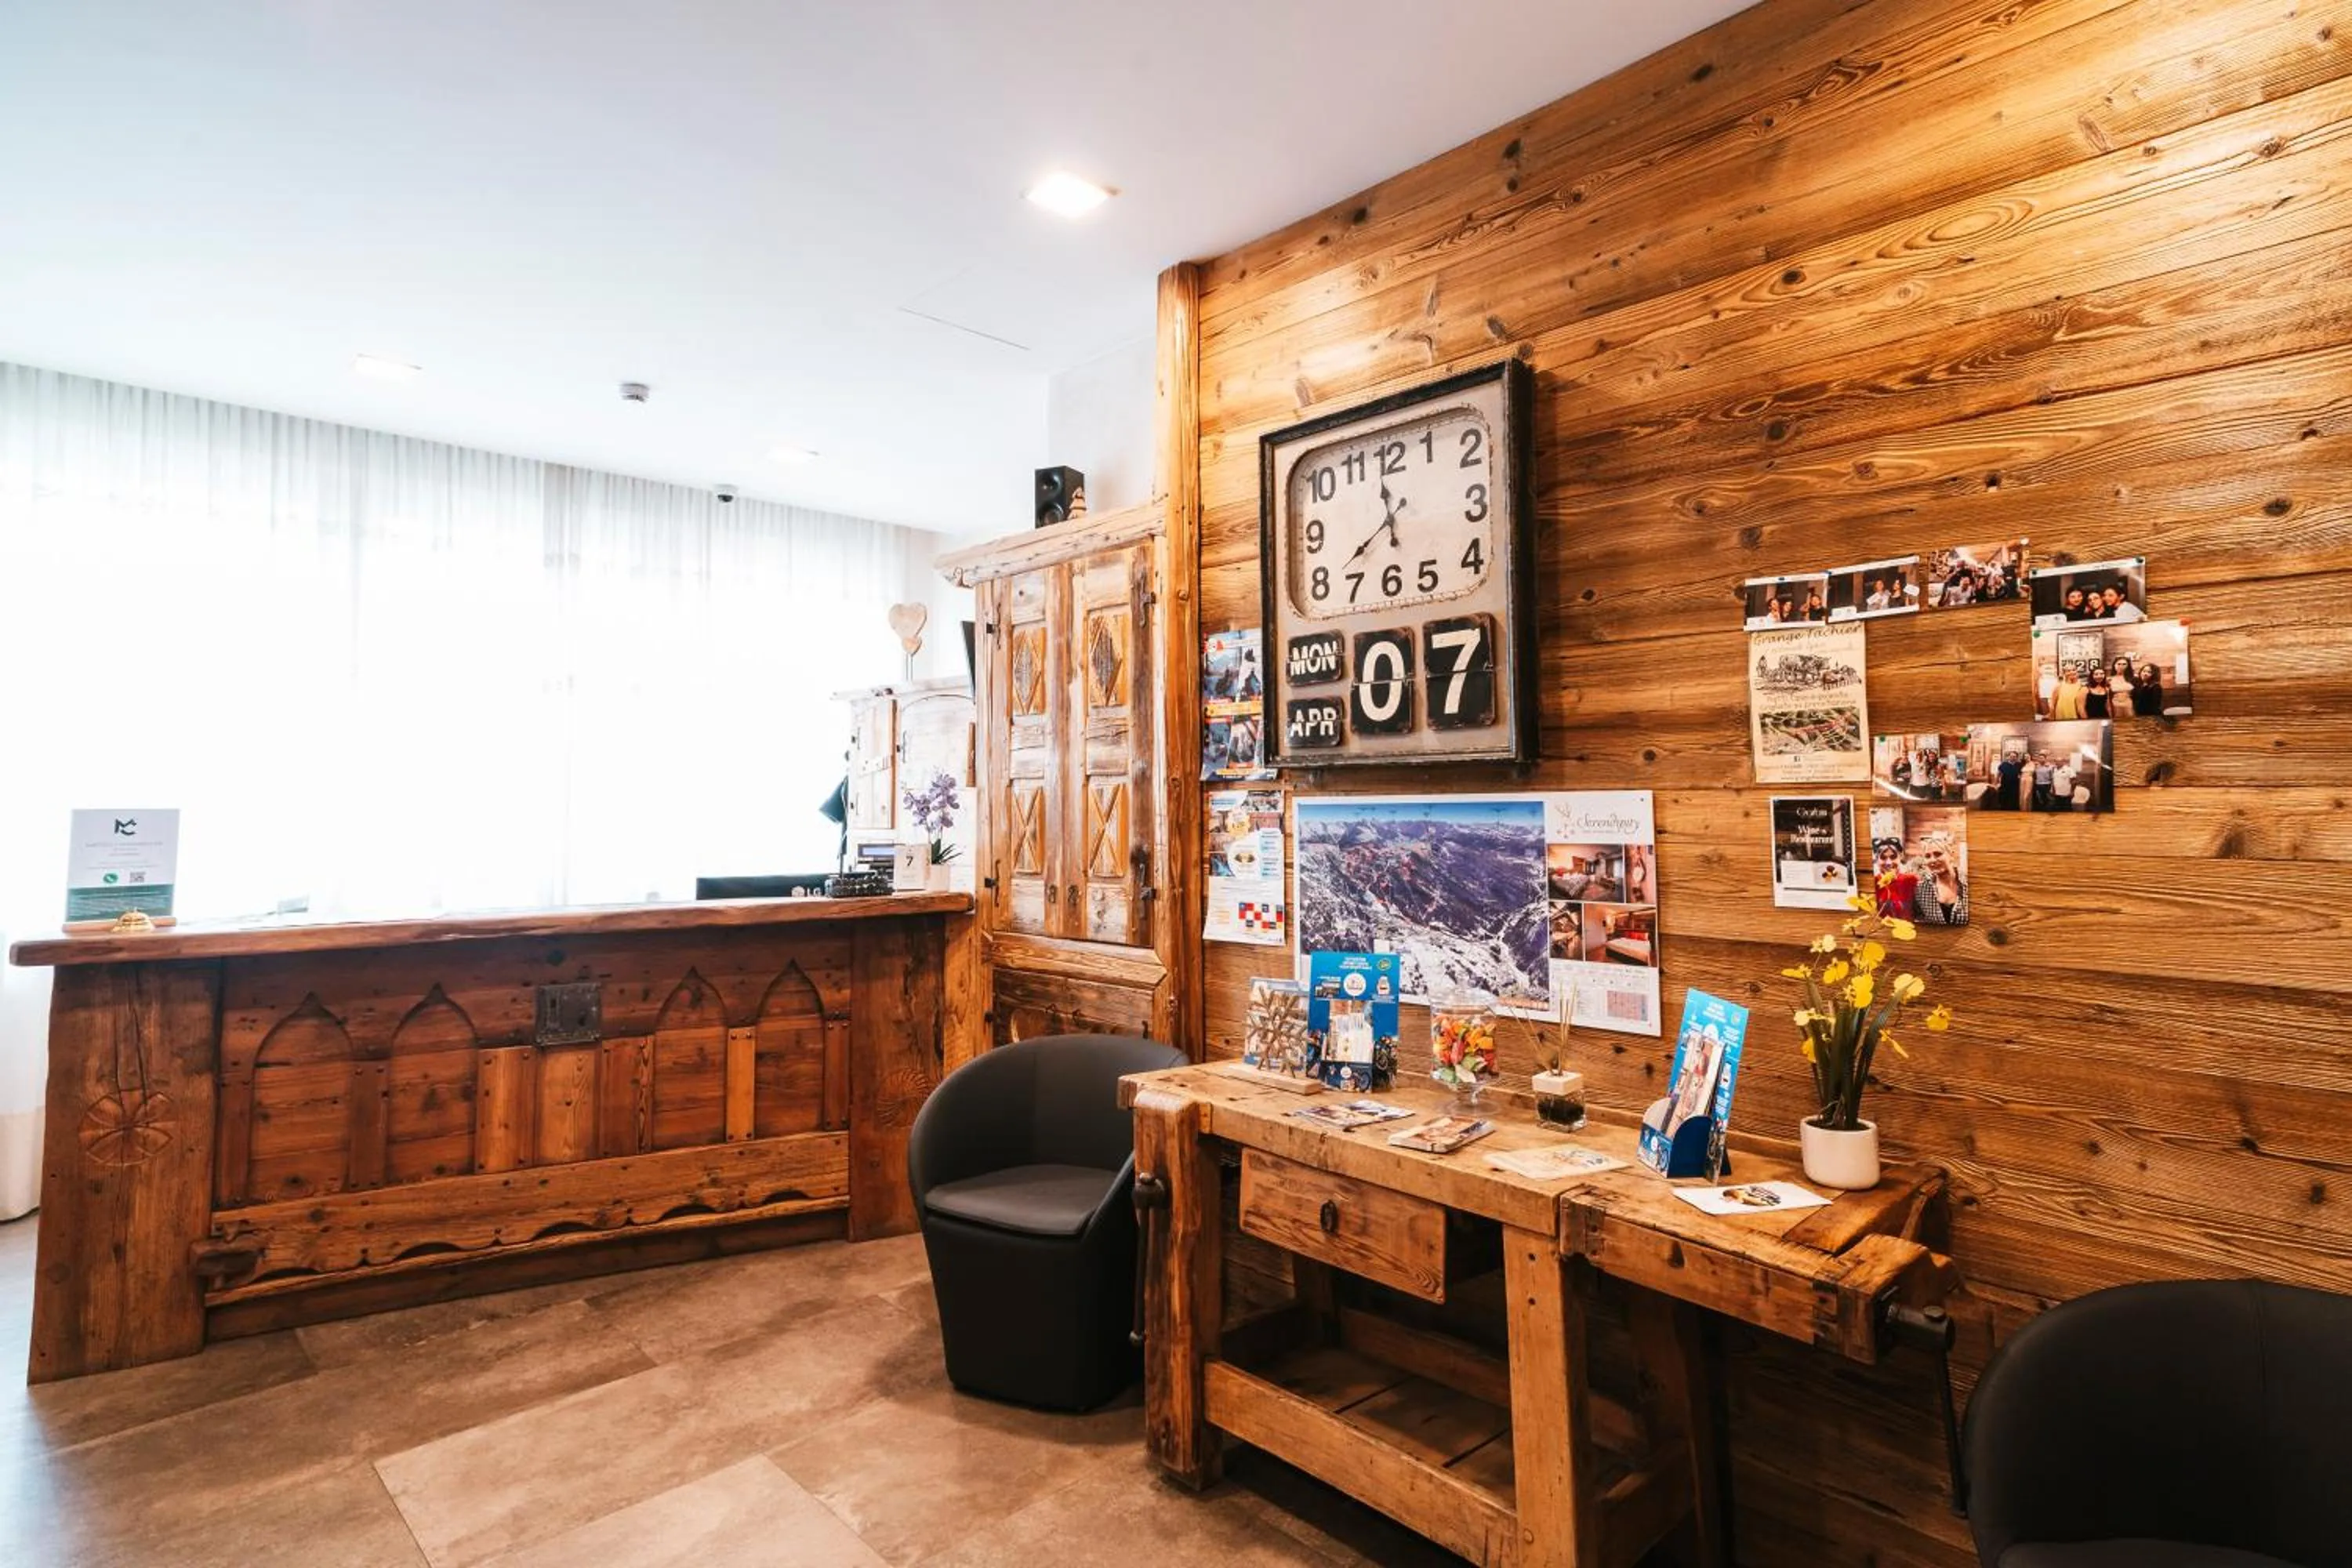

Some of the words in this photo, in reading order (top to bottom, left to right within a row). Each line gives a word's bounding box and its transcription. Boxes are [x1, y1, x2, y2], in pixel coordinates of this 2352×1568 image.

[1374, 441, 1406, 477] 12
[1419, 431, 1433, 464] 1
[1459, 428, 1483, 469] 2
[1307, 466, 1336, 503] 10
[1341, 451, 1366, 485] 11
[1465, 483, 1488, 523] 3
[1305, 520, 1325, 554] 9
[1461, 537, 1484, 575] 4
[1312, 566, 1330, 601] 8
[1345, 572, 1365, 603] 7
[1381, 564, 1403, 597] 6
[1417, 559, 1439, 593] 5
[1290, 641, 1338, 677] MON
[1290, 709, 1337, 739] APR
[906, 855, 913, 866] 7
